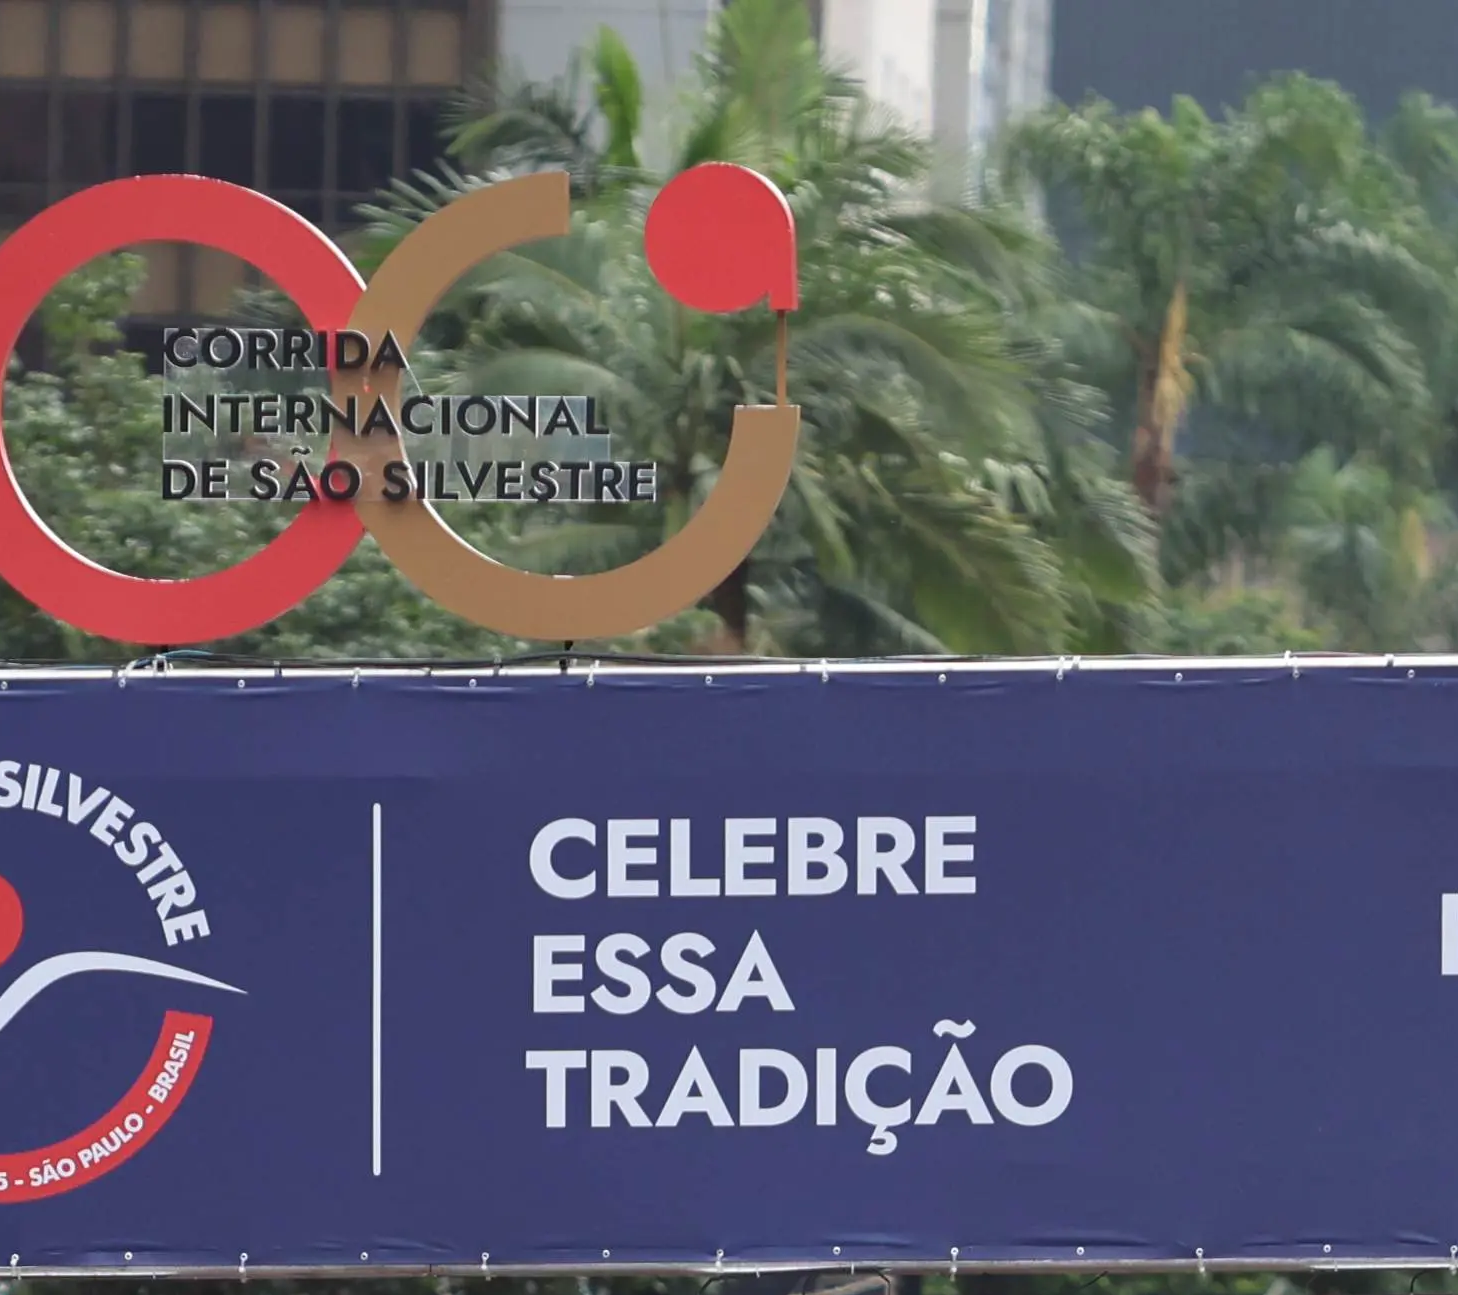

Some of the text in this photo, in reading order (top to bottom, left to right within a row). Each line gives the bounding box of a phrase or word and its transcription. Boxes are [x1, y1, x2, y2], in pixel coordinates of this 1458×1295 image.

[163, 327, 407, 372] CORRIDA
[163, 393, 609, 440] INTERNACIONAL
[163, 447, 656, 503] DE SÃO SILVESTRE
[529, 815, 977, 900] CELEBRE
[533, 929, 796, 1015] ESSA
[28, 1157, 76, 1189] SÃO
[77, 1111, 145, 1169] PAULO
[148, 1028, 195, 1103] BRASIL
[525, 1019, 1074, 1156] TRADIÇÃO
